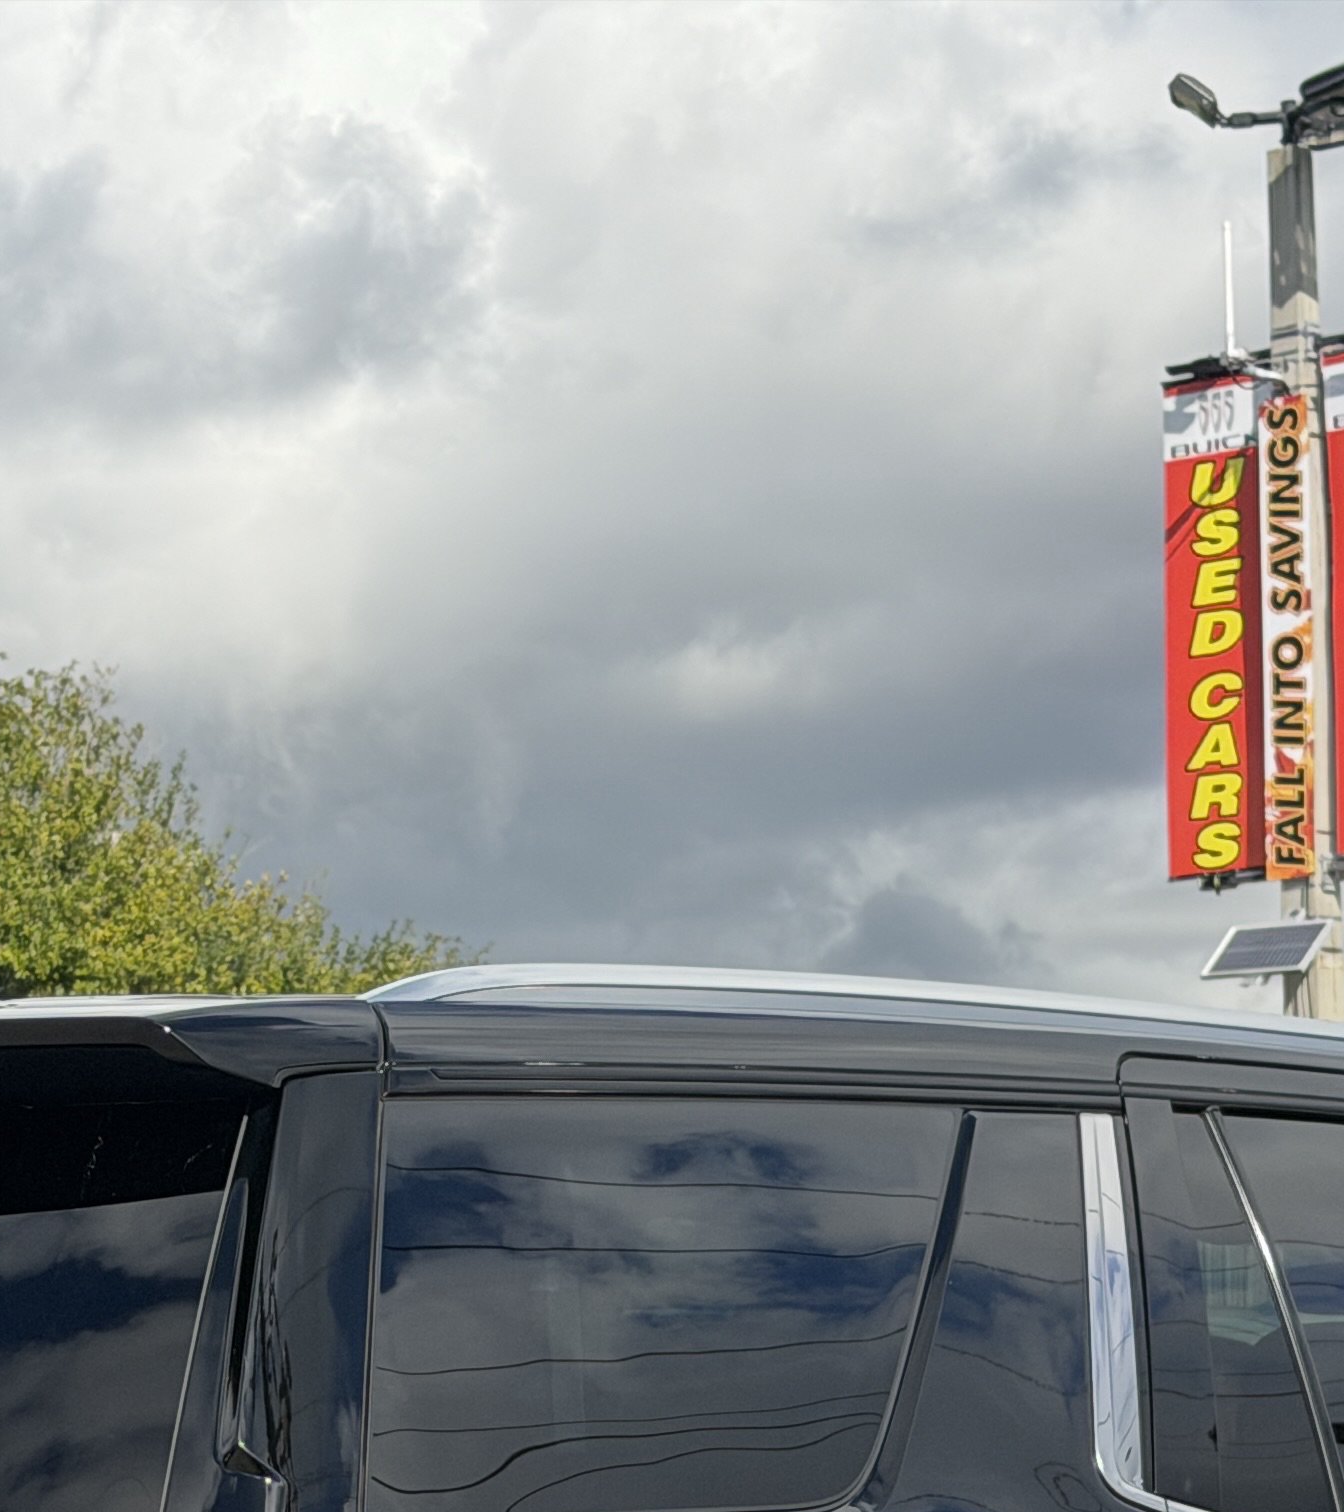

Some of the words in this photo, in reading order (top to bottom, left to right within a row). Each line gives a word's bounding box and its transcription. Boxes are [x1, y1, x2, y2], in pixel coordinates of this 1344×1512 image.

[1188, 457, 1245, 658] USED
[1266, 405, 1304, 614] SAVINGS
[1185, 671, 1244, 869] CARS
[1271, 635, 1305, 746] INTO
[1273, 767, 1306, 867] FALL
